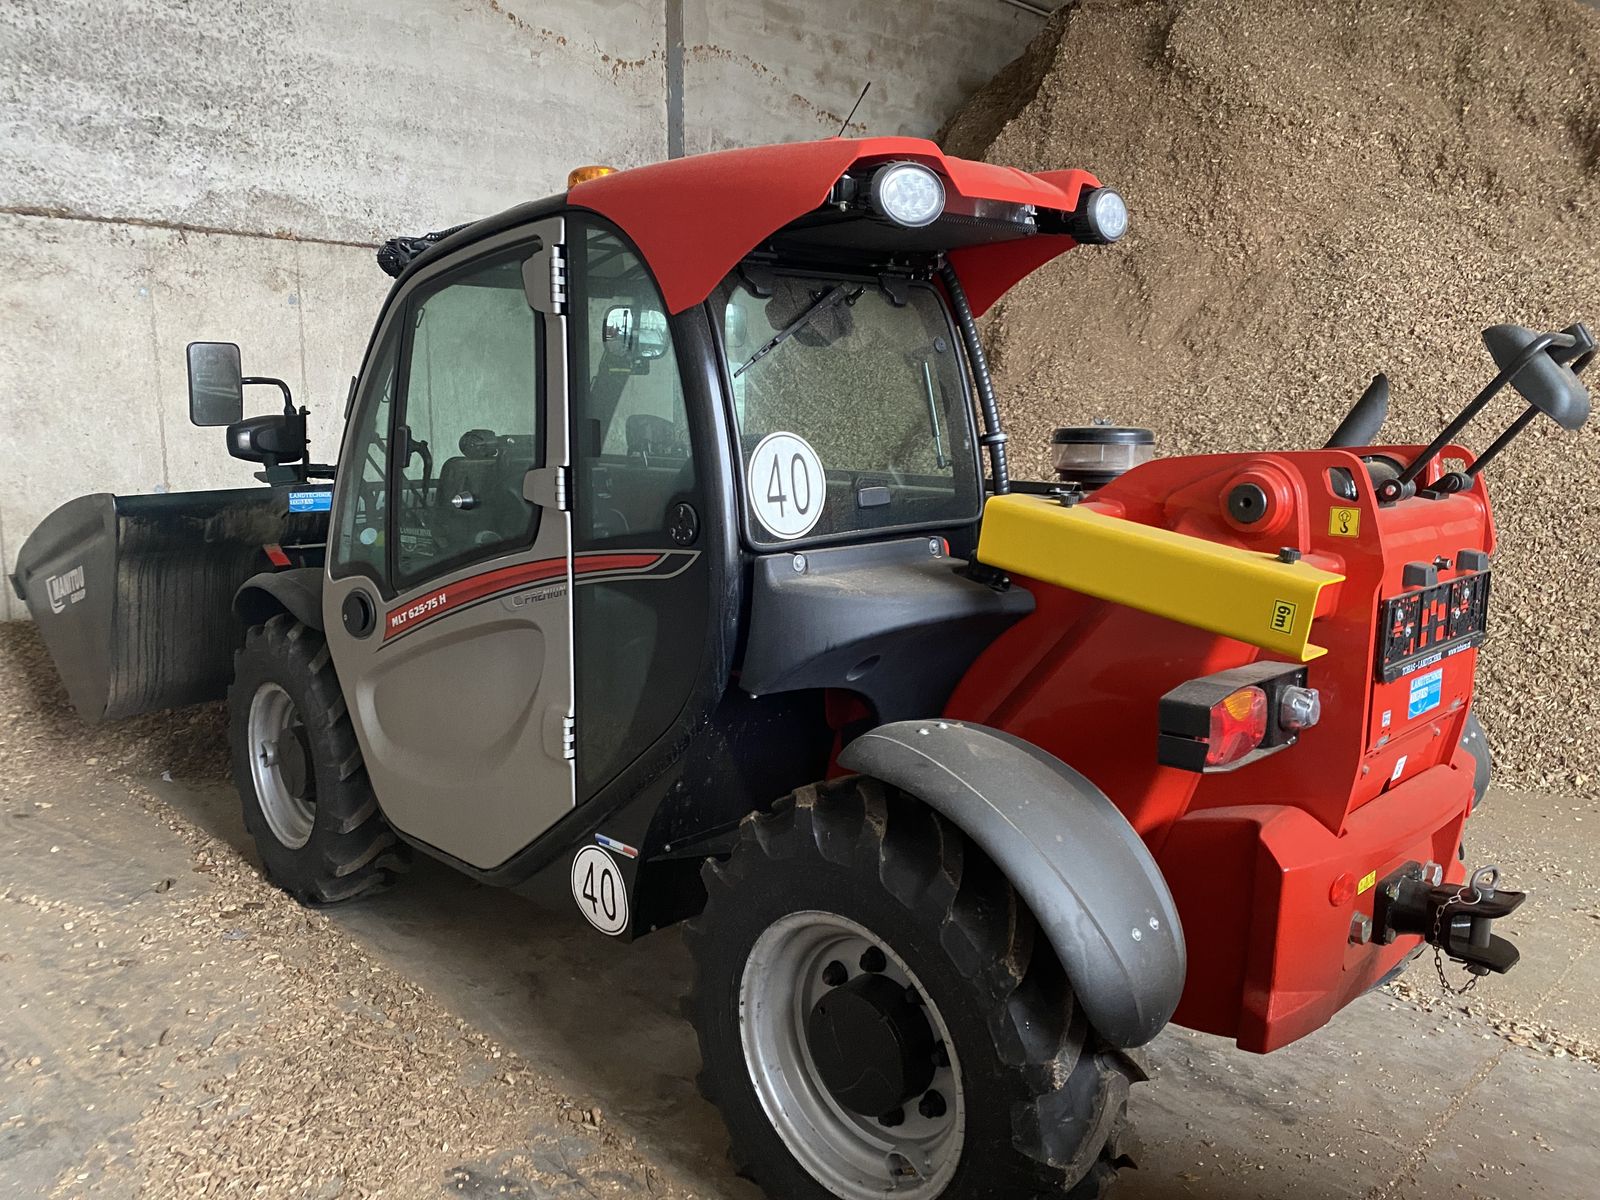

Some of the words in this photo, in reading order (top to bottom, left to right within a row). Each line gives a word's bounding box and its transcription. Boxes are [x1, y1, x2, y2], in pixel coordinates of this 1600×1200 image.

[766, 452, 811, 518] 40
[391, 611, 408, 628] MLT
[438, 592, 447, 605] H
[1274, 604, 1291, 628] 6m
[582, 861, 617, 922] 40
